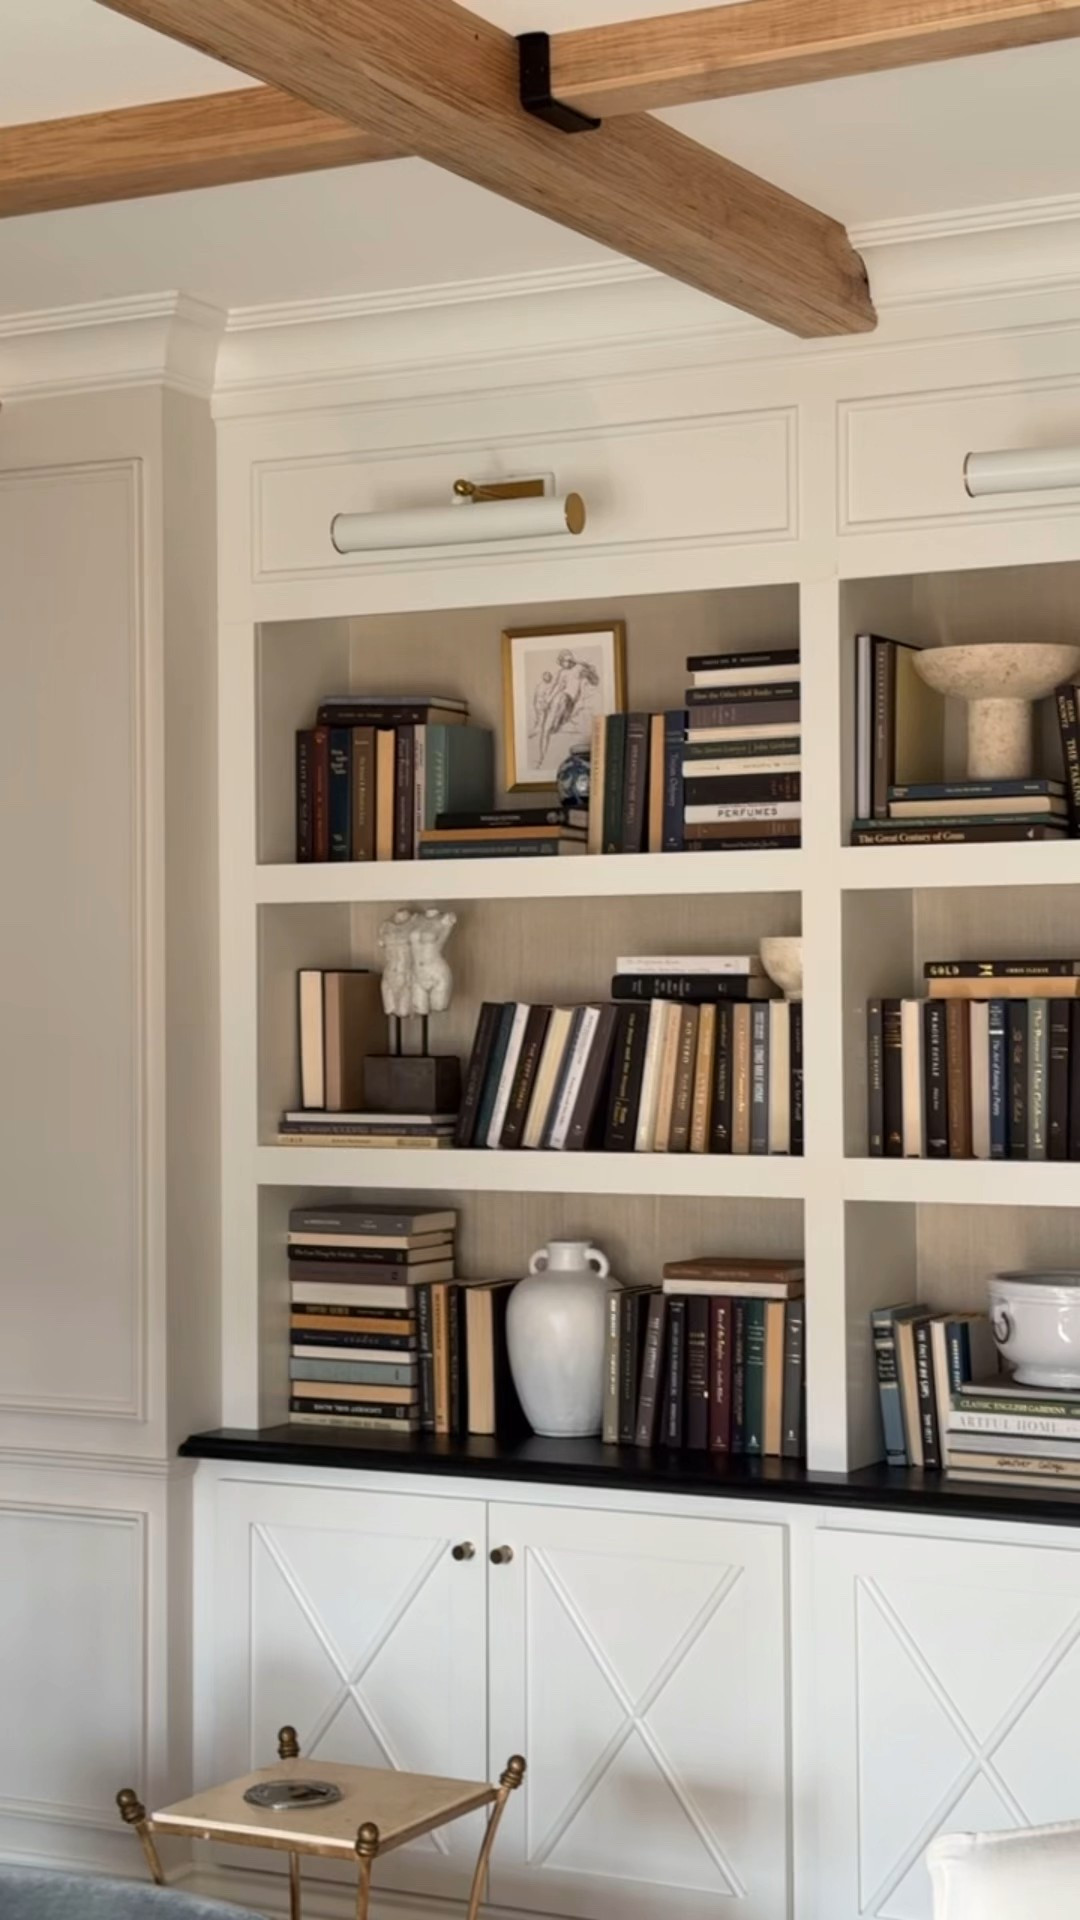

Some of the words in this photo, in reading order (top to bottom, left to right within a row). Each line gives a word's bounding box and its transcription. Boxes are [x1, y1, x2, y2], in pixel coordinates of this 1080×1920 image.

[1059, 696, 1069, 728] KOONTZ
[1066, 700, 1075, 722] DEAN
[1066, 739, 1078, 761] THE
[717, 804, 778, 818] PERFUMES
[859, 835, 874, 844] The
[875, 834, 898, 843] Great
[899, 833, 931, 844] Century
[932, 832, 941, 842] of
[929, 965, 960, 976] GOLD
[1033, 1008, 1042, 1027] The
[931, 1011, 939, 1046] PRAGUE
[754, 1044, 764, 1064] LONG
[931, 1047, 940, 1077] FATALE
[754, 1064, 764, 1083] MILE
[754, 1083, 764, 1103] HOME
[960, 1400, 993, 1411] CLASSIC
[993, 1401, 1027, 1412] ENGLISH
[1027, 1403, 1066, 1415] GARDENS
[960, 1415, 1010, 1430] ARTFUL
